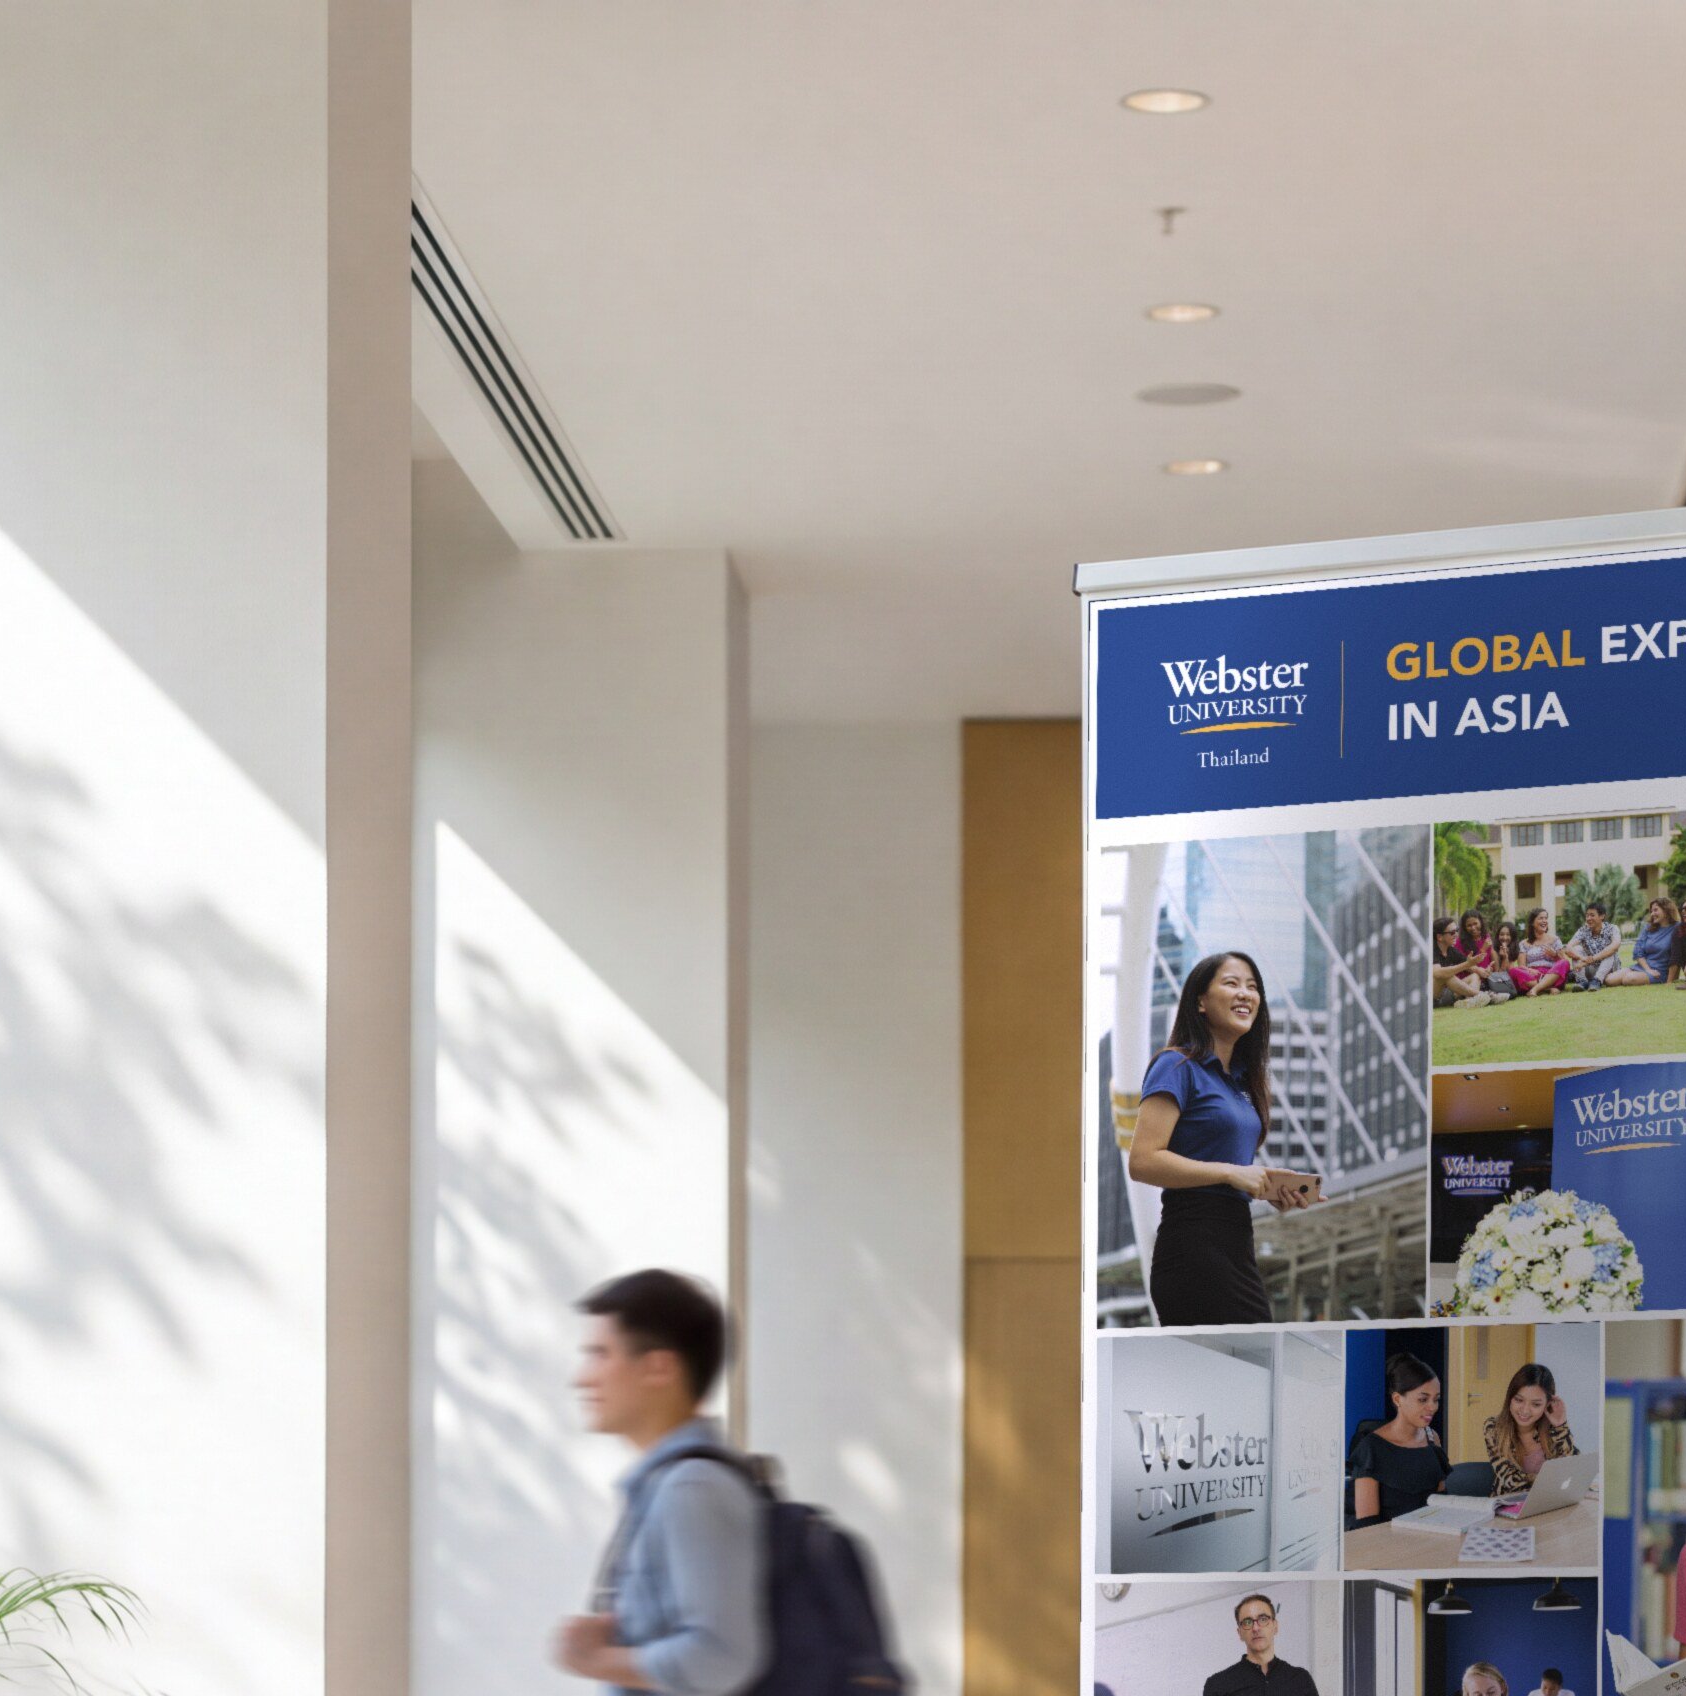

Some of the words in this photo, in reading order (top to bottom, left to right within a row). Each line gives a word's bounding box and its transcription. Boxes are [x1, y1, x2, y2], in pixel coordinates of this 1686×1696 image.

[1160, 654, 1309, 698] Webster
[1386, 629, 1586, 681] GLOBAL
[1167, 694, 1308, 725] UNIVERSITY
[1388, 700, 1438, 741] IN
[1453, 691, 1570, 737] ASIA
[1197, 746, 1269, 768] Thailand
[1441, 1153, 1514, 1177] Webster
[1443, 1177, 1512, 1190] UNIVERSITY
[1123, 1409, 1268, 1474] Webster
[1135, 1474, 1267, 1521] UNIVERSITY
